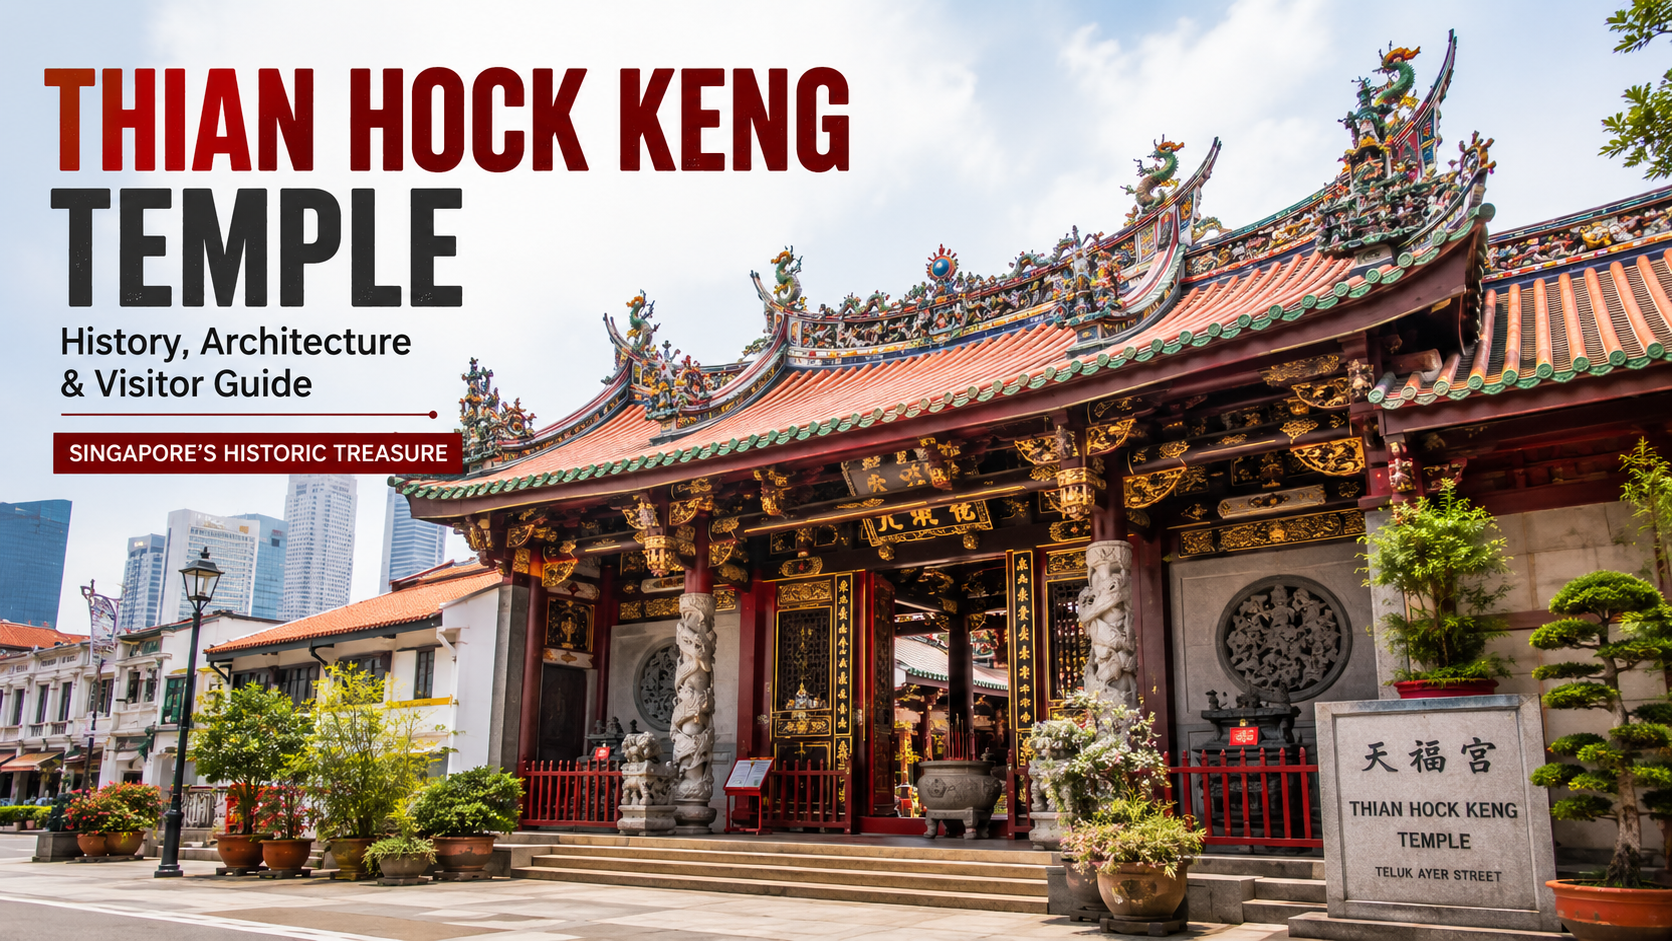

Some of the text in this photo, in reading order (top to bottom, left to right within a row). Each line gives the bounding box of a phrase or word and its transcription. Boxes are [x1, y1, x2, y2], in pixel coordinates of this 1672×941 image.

[1349, 801, 1518, 819] THIAN HOCK KENG
[1397, 832, 1471, 849] TEMPLE
[1375, 866, 1502, 882] TELUK AYER STREET
